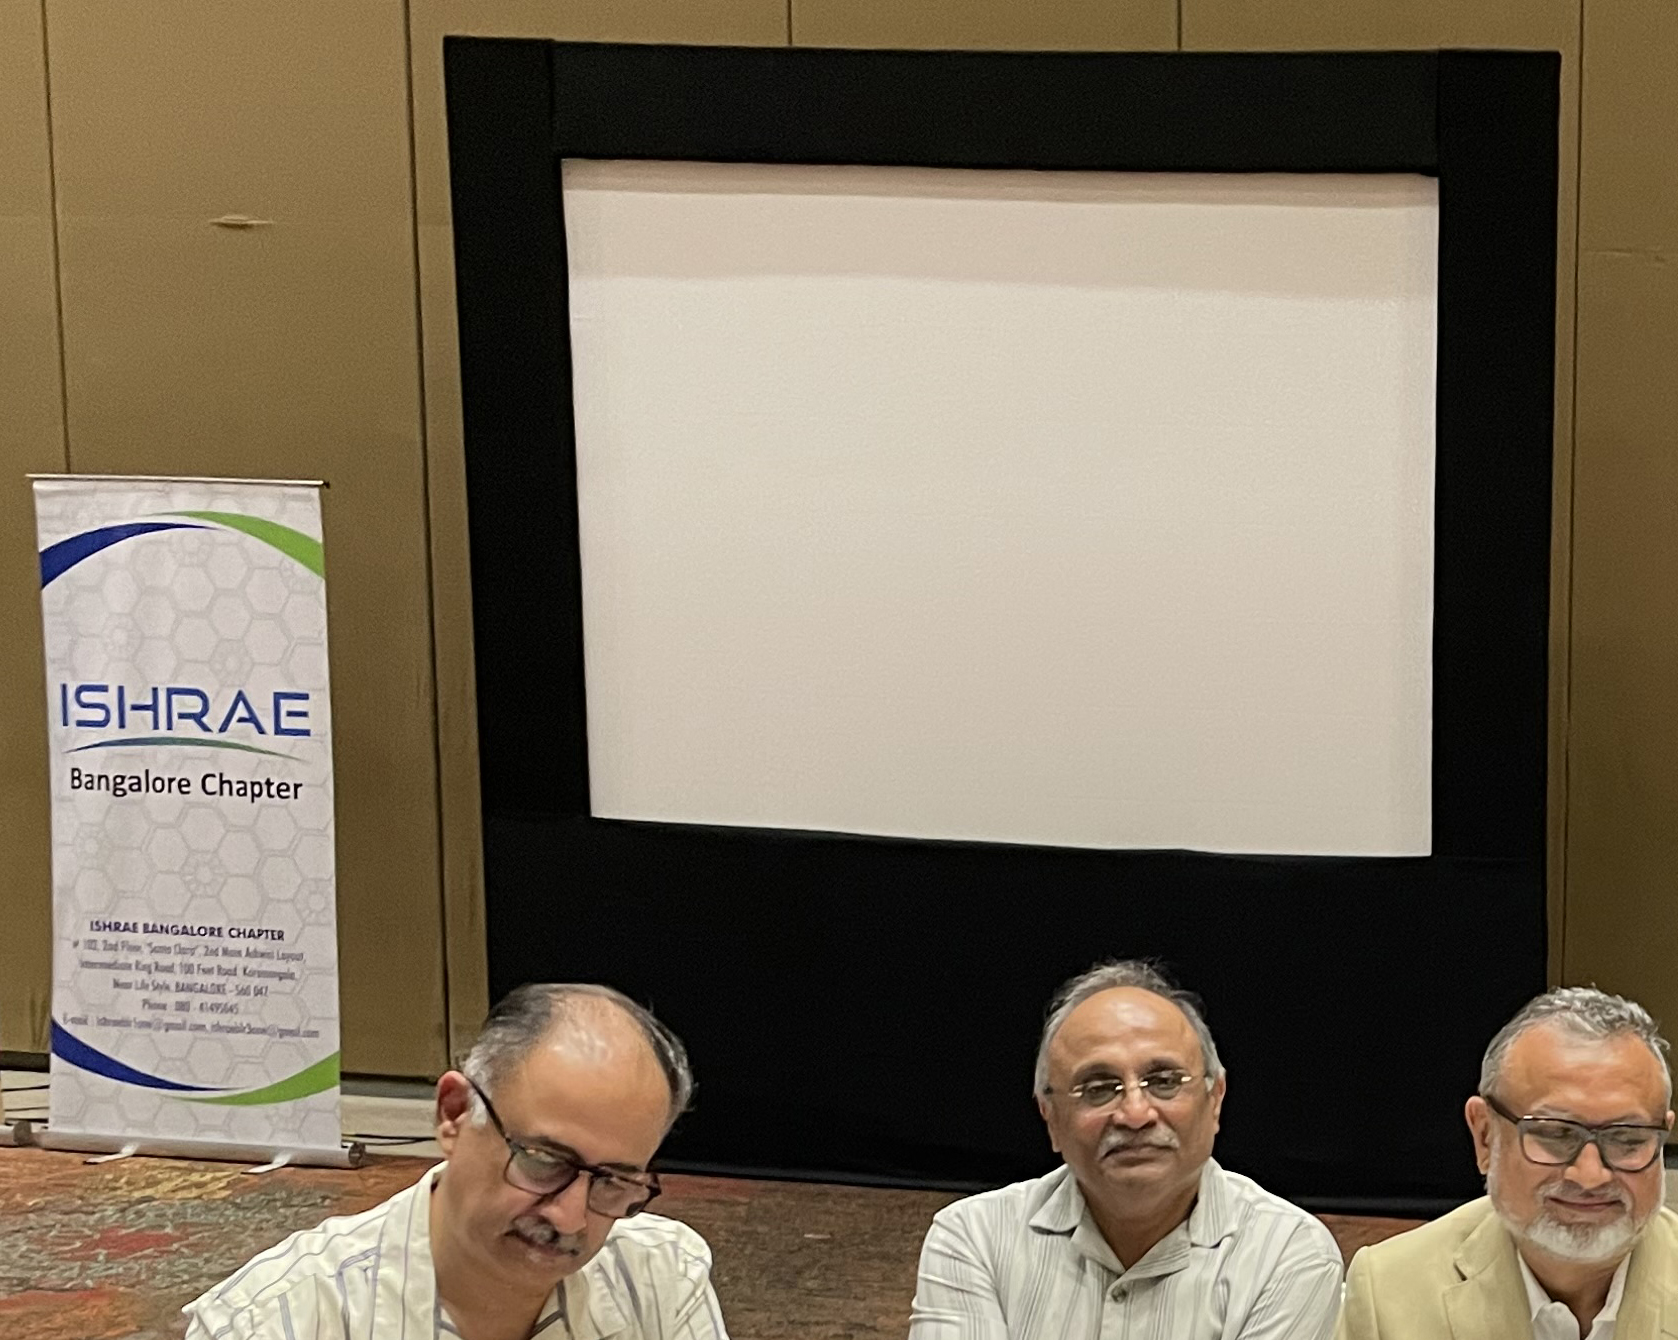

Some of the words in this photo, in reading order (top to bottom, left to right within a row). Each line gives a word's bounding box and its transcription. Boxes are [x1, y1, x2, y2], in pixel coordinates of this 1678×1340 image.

[60, 683, 311, 737] ISHRAE
[71, 767, 191, 798] Bangalore
[201, 773, 304, 803] Chapter
[90, 920, 138, 933] ISHRAE
[143, 920, 224, 938] BANGALORE
[228, 927, 285, 941] CHAPTER
